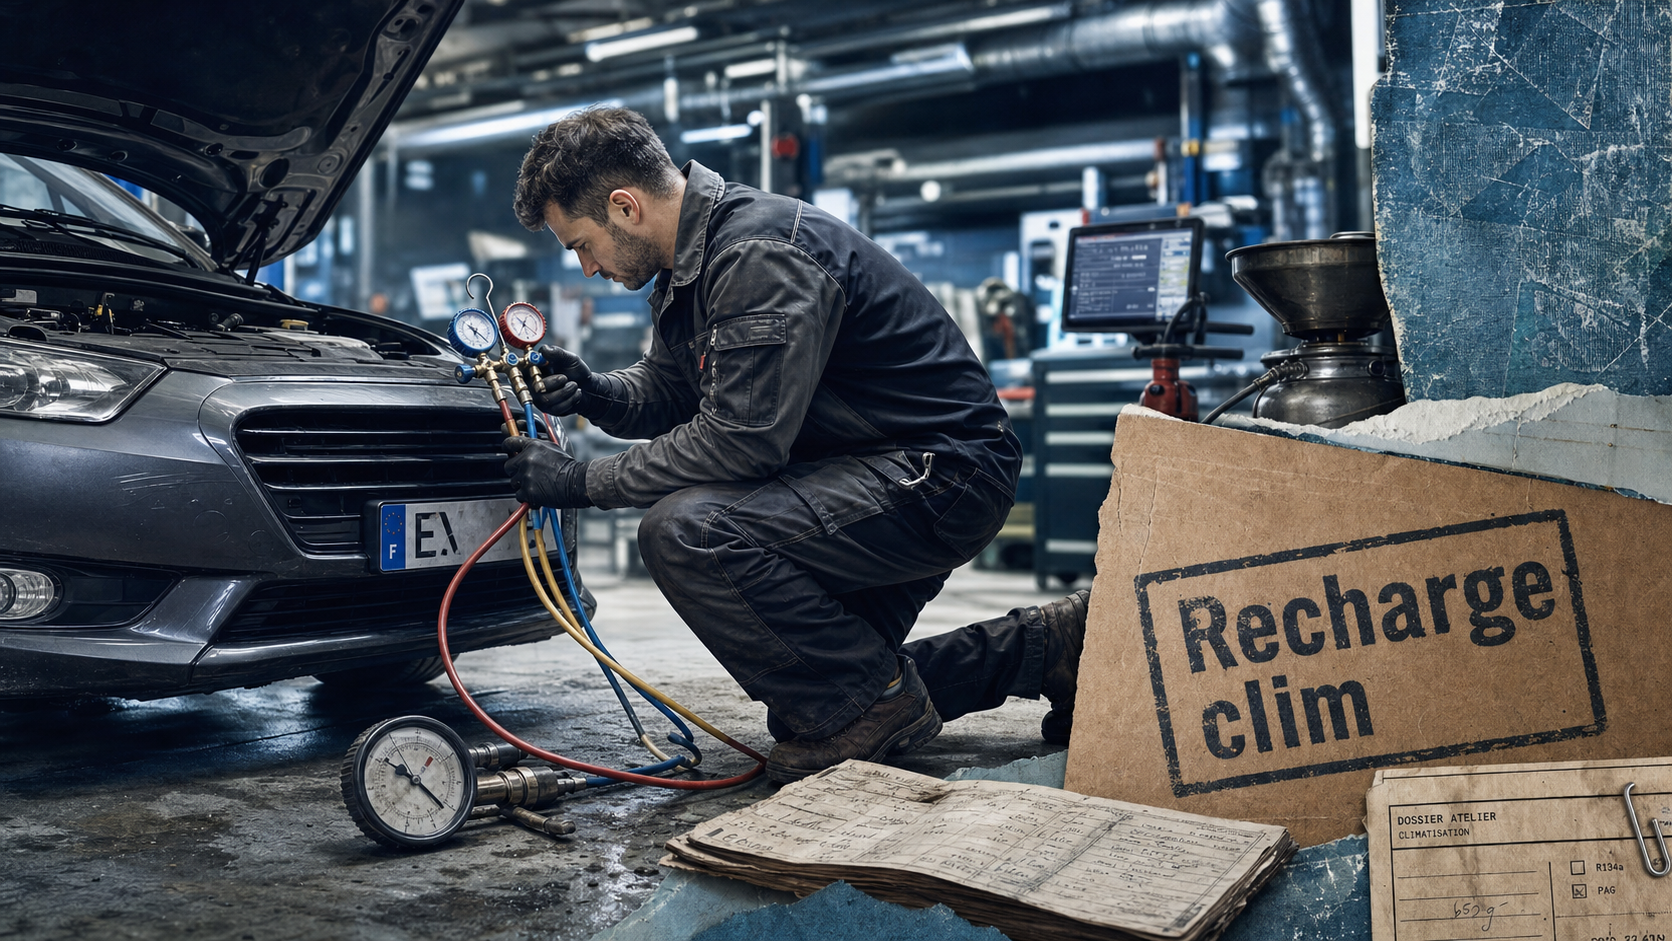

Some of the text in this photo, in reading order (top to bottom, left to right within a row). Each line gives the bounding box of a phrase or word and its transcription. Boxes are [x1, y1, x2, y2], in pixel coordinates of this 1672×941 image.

[389, 543, 398, 560] F
[1178, 561, 1556, 675] Recharge
[1201, 675, 1375, 760] clim
[1397, 811, 1497, 826] DOSSIER ATELIER
[1596, 862, 1624, 872] R134a
[1597, 885, 1616, 895] PAG
